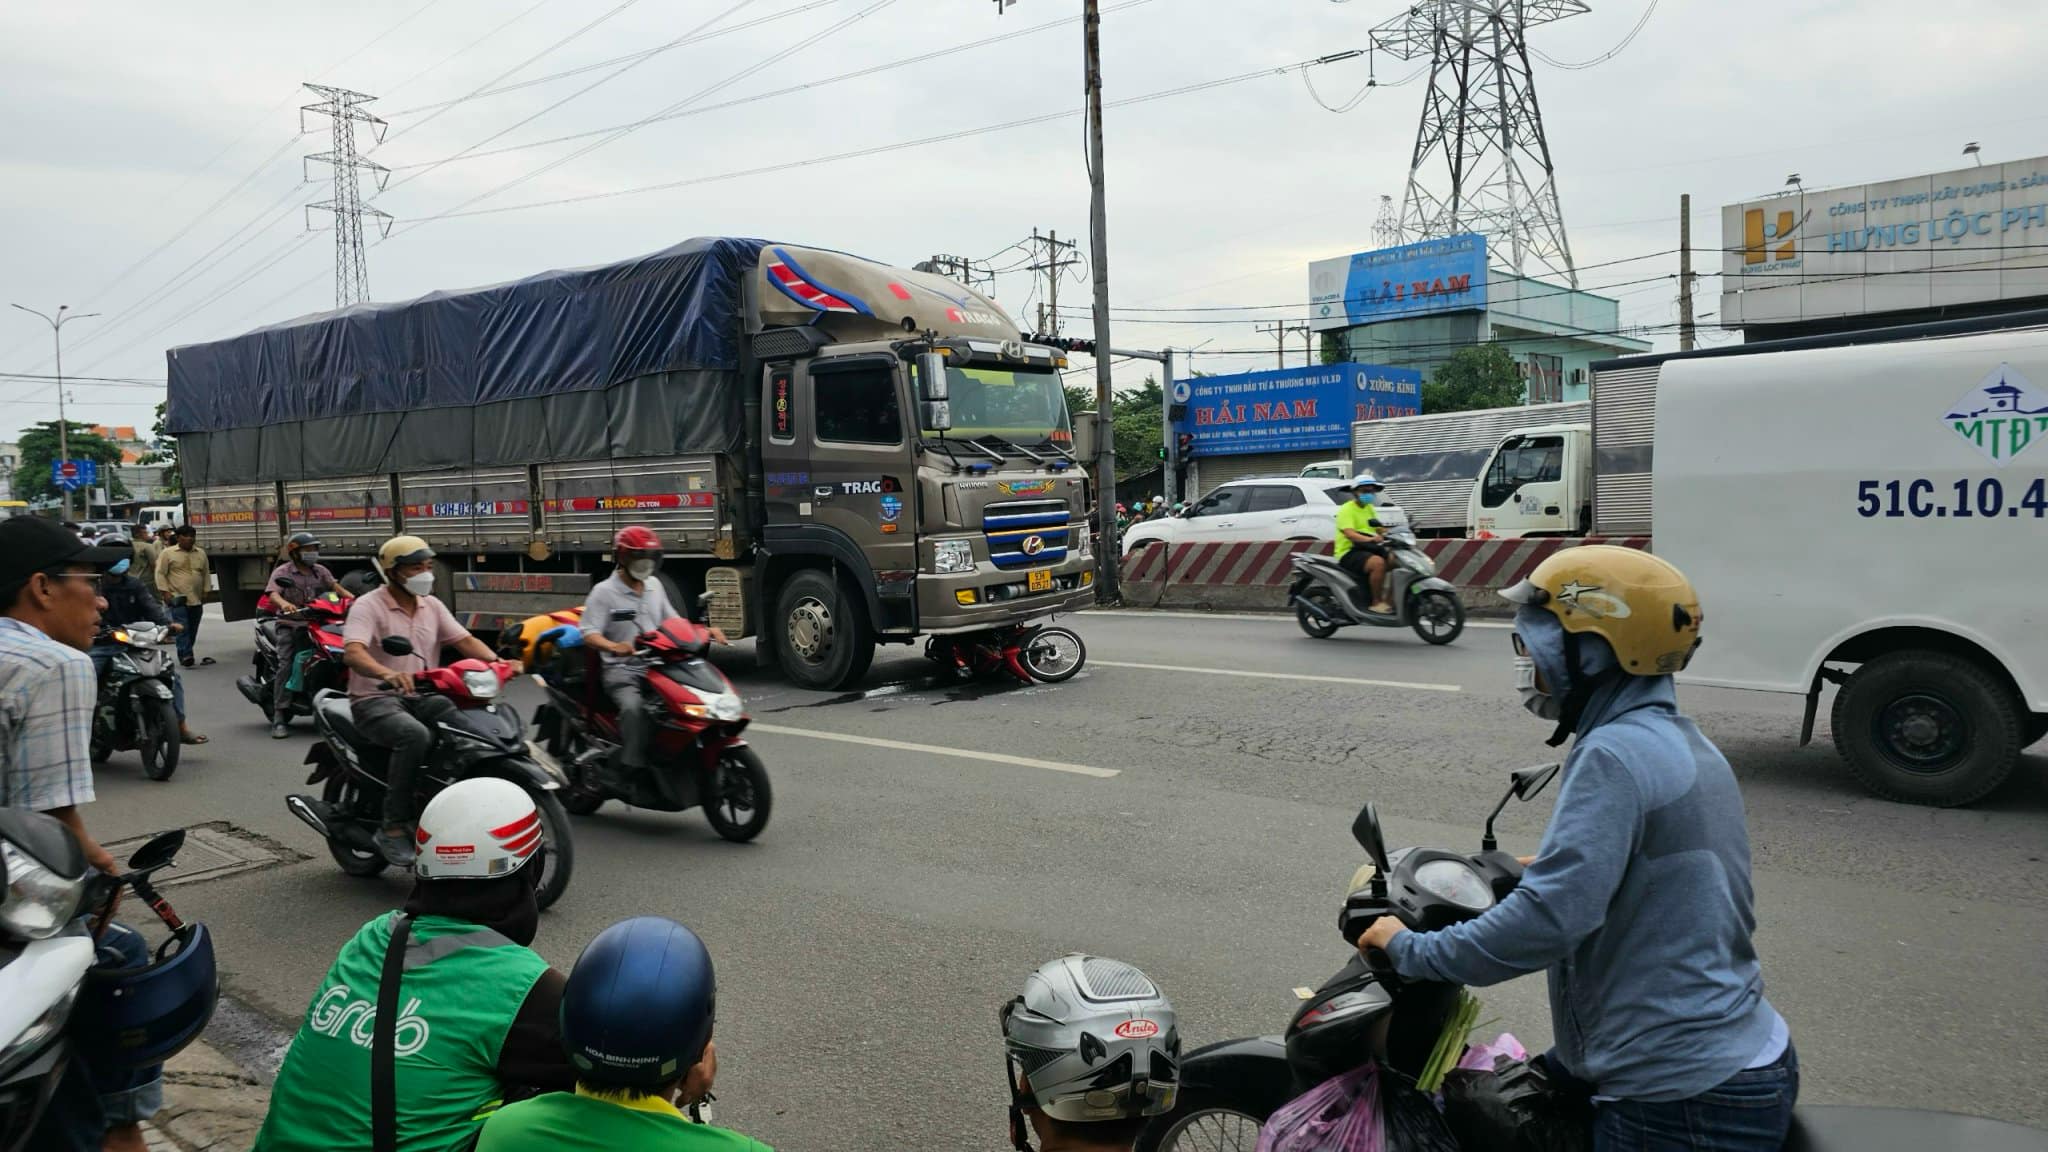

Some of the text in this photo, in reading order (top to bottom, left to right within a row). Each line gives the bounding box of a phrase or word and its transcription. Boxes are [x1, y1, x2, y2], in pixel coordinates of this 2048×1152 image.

[1828, 202, 1866, 217] CÔNG
[1870, 198, 1888, 211] TY
[1892, 193, 1930, 208] TNHH
[1932, 185, 1960, 202] XÂY
[1963, 180, 2007, 198] DỰNG
[1826, 203, 2047, 254] HƯNG LỘC PH
[1411, 274, 1471, 300] NAM
[1195, 384, 1213, 397] CÔNG
[1214, 386, 1223, 396] TY
[1224, 384, 1242, 395] TNHH
[1396, 379, 1416, 394] KÍNH
[1195, 399, 1318, 426] HẢI NAM
[842, 480, 894, 494] TRAGO
[598, 498, 637, 510] TRAGO
[1857, 478, 2048, 518] 51C.10.4
[211, 511, 254, 522] HYUNDAI
